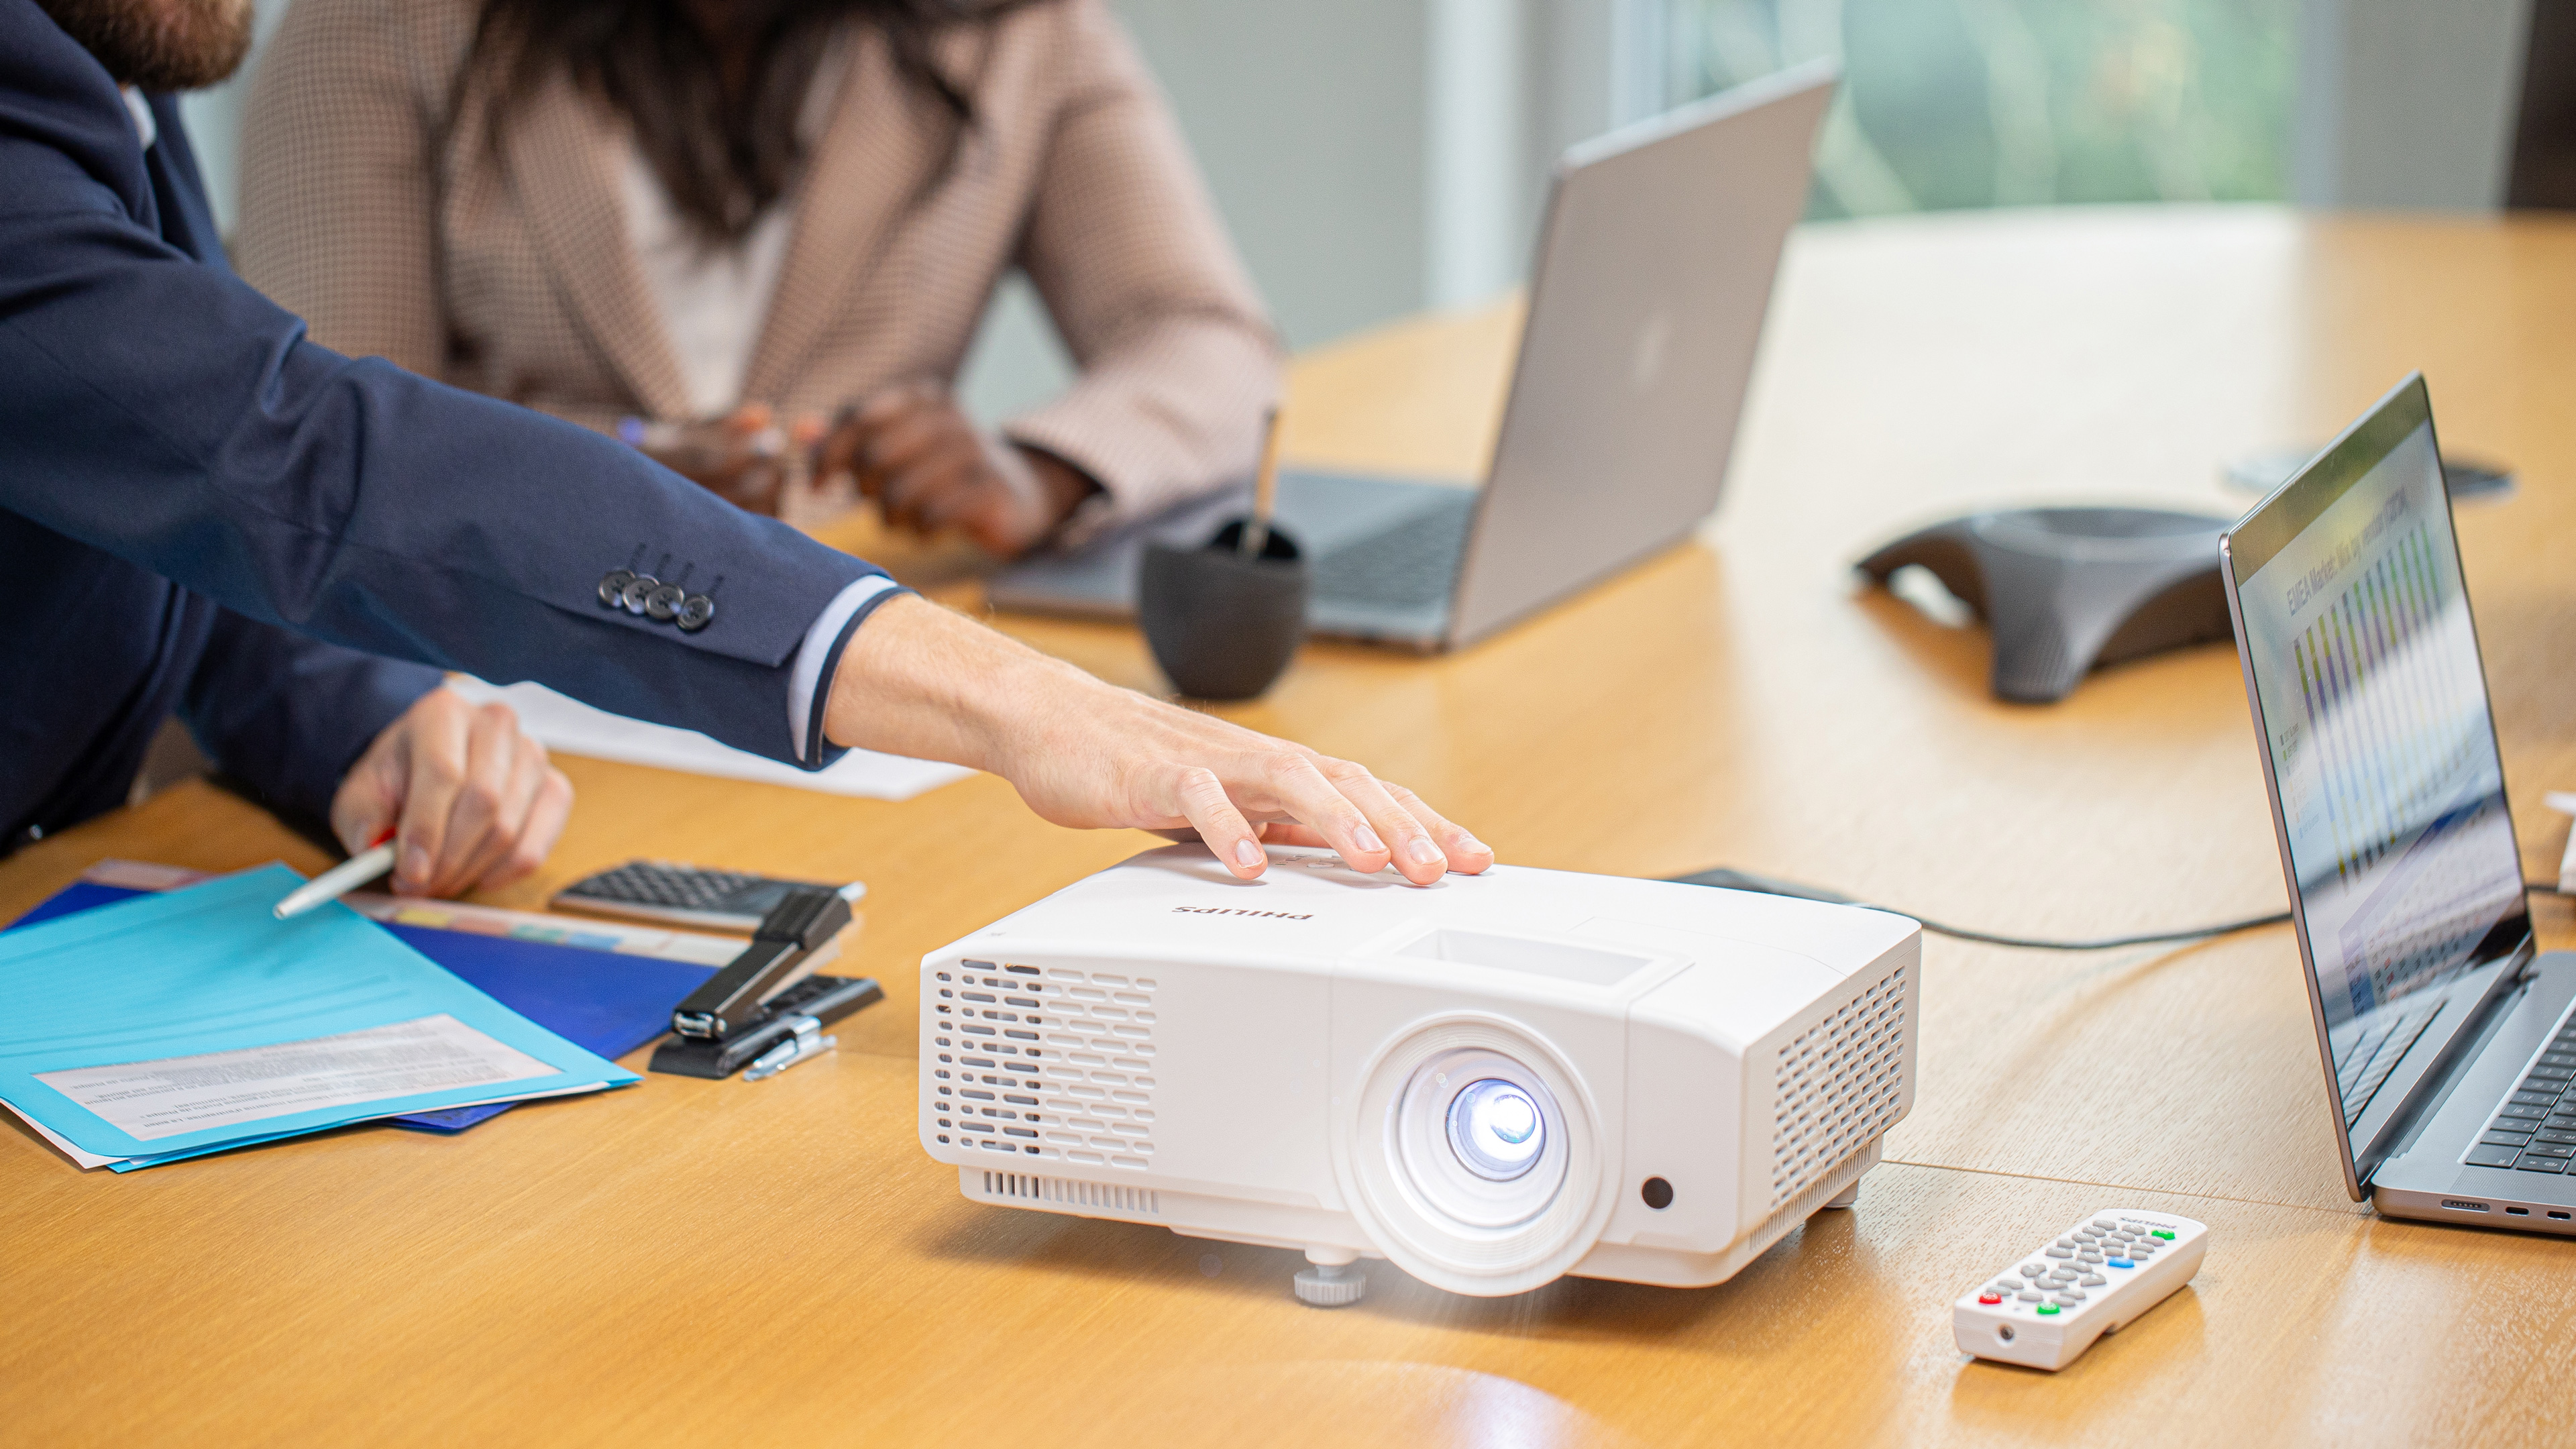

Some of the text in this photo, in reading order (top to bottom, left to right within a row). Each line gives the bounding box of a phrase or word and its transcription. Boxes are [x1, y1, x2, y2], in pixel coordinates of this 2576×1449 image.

[2287, 575, 2312, 617] EMEA
[1171, 906, 1314, 920] PHILIPS
[2118, 1216, 2178, 1229] PHILIPS
